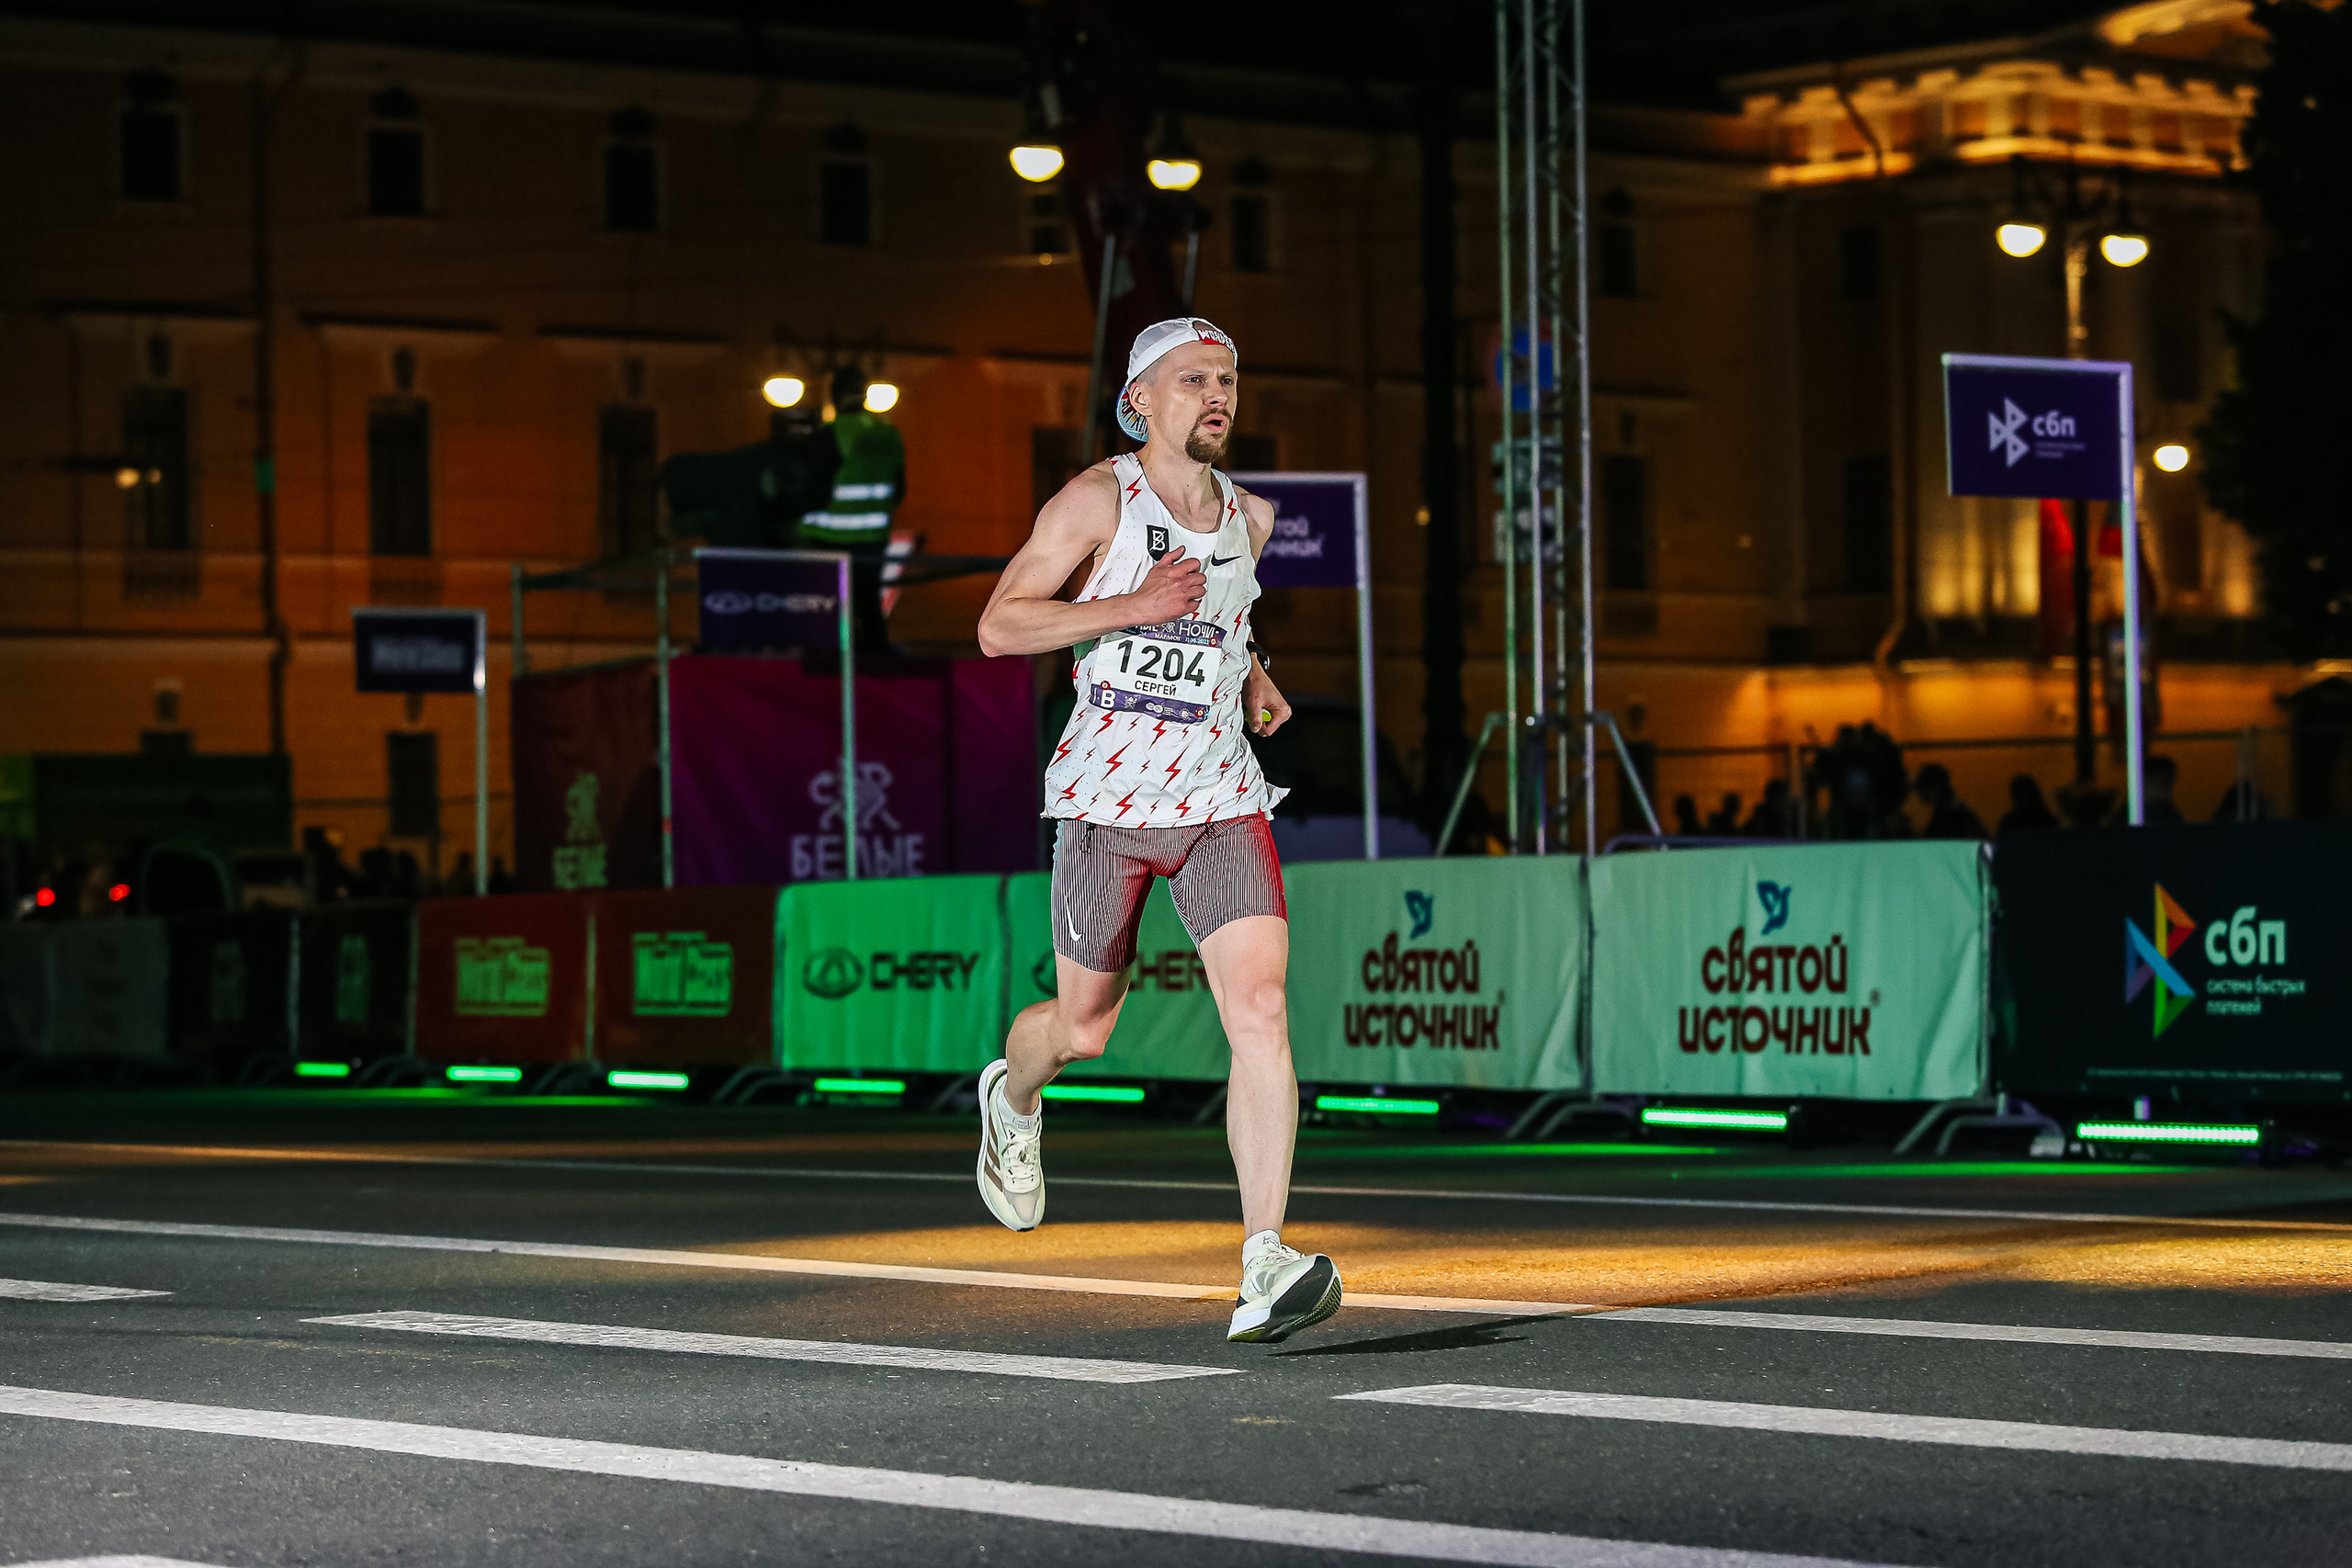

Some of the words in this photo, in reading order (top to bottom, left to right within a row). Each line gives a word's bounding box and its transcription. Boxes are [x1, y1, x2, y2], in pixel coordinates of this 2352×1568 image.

[1117, 639, 1205, 687] 1204
[1135, 680, 1177, 696] СЕРГЕЙ
[872, 951, 980, 990] CHERY
